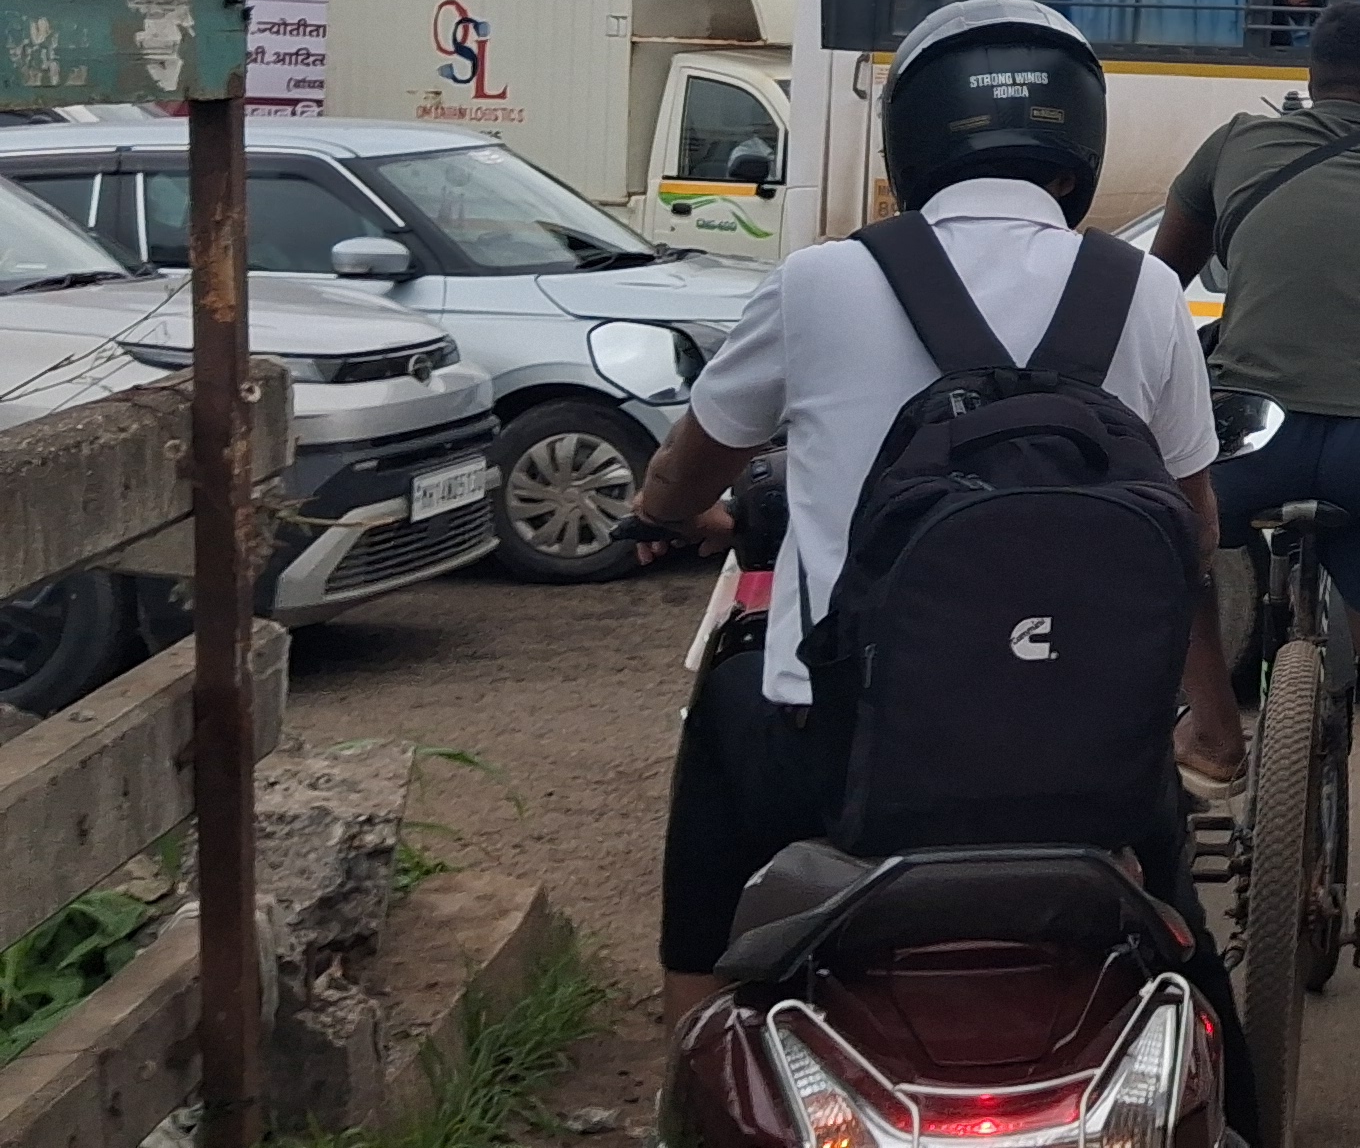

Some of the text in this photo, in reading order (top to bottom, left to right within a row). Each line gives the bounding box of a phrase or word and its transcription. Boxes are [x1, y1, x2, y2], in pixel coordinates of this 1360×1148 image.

[969, 71, 1049, 88] STRONG WINGS
[993, 85, 1029, 99] HONDA
